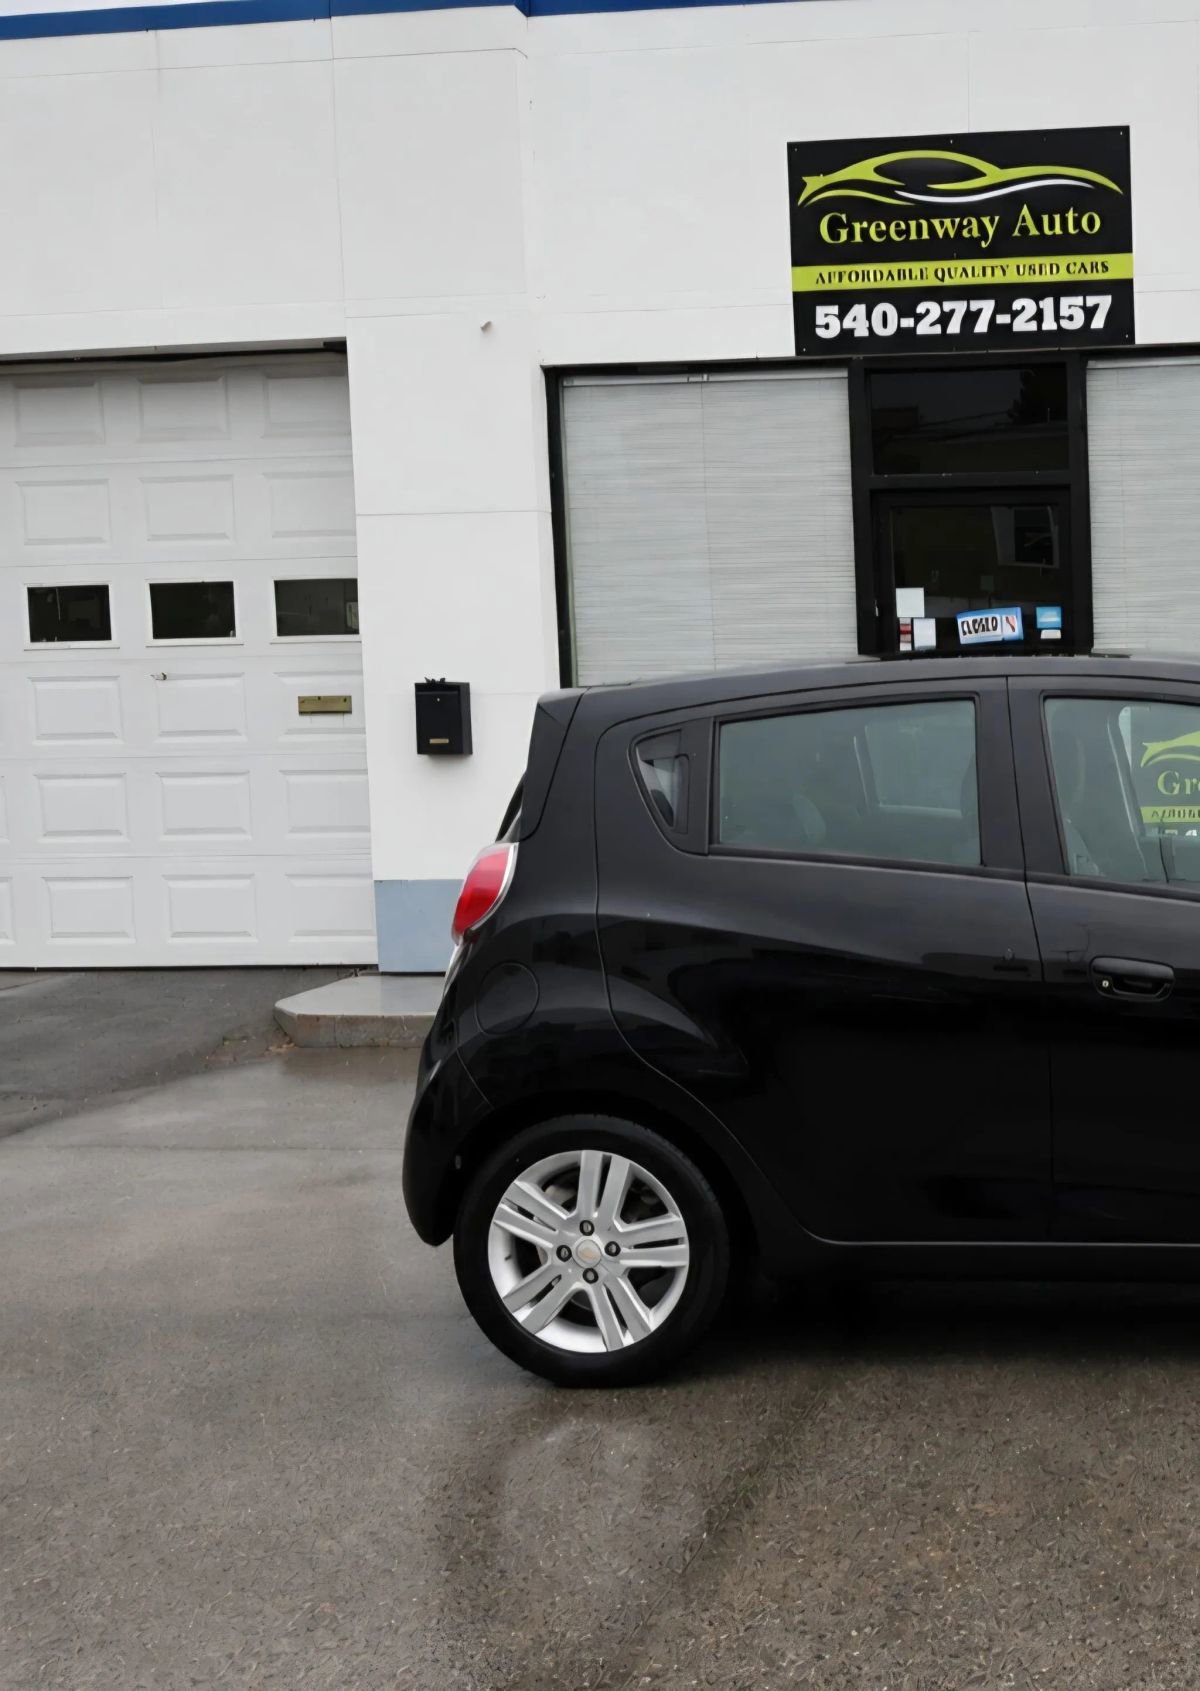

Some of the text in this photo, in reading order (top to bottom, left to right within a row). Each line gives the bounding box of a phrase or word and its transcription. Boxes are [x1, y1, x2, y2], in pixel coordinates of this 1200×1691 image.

[819, 203, 1101, 248] Greenway Auto
[815, 261, 1109, 285] AFFORDABLE QUALITY USED CARS
[814, 295, 1112, 339] 540-277-2157
